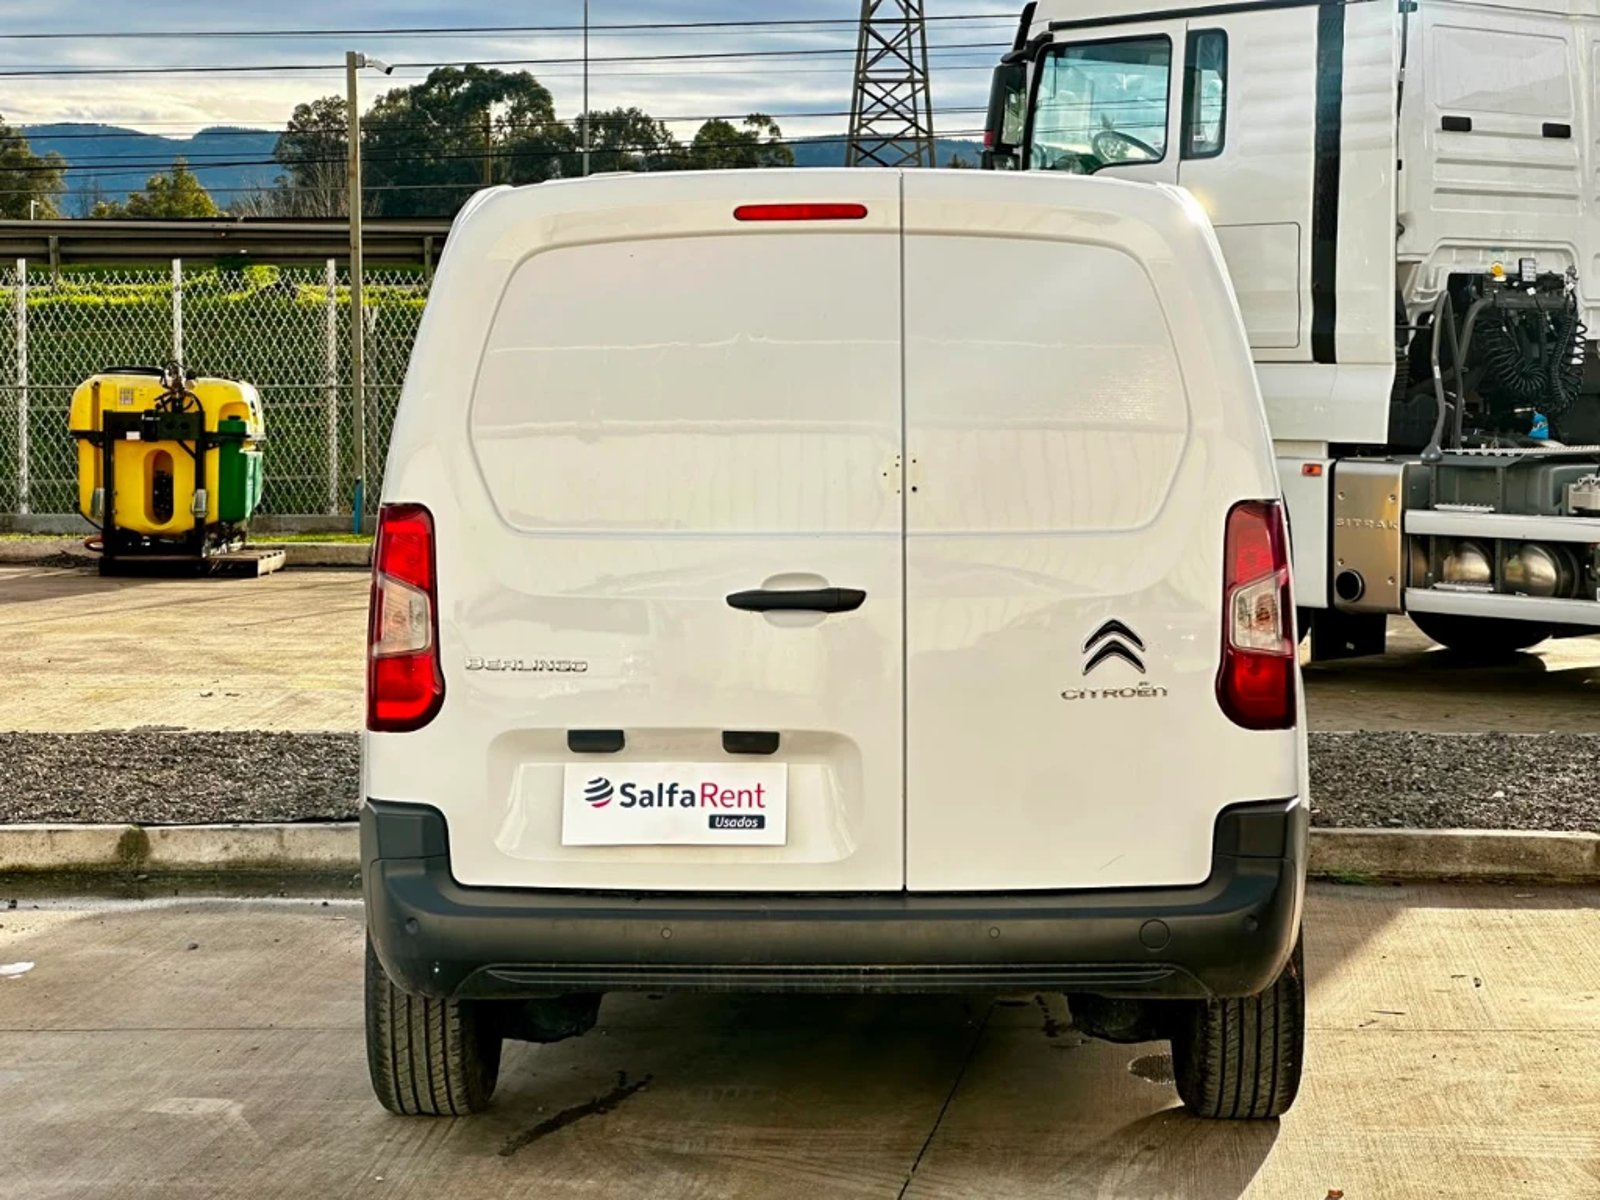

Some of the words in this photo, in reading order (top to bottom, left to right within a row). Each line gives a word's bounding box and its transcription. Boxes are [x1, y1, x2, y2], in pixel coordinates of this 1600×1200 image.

[465, 657, 588, 673] BERLINGO
[619, 782, 766, 808] SalfaRent
[714, 815, 759, 828] Usados
